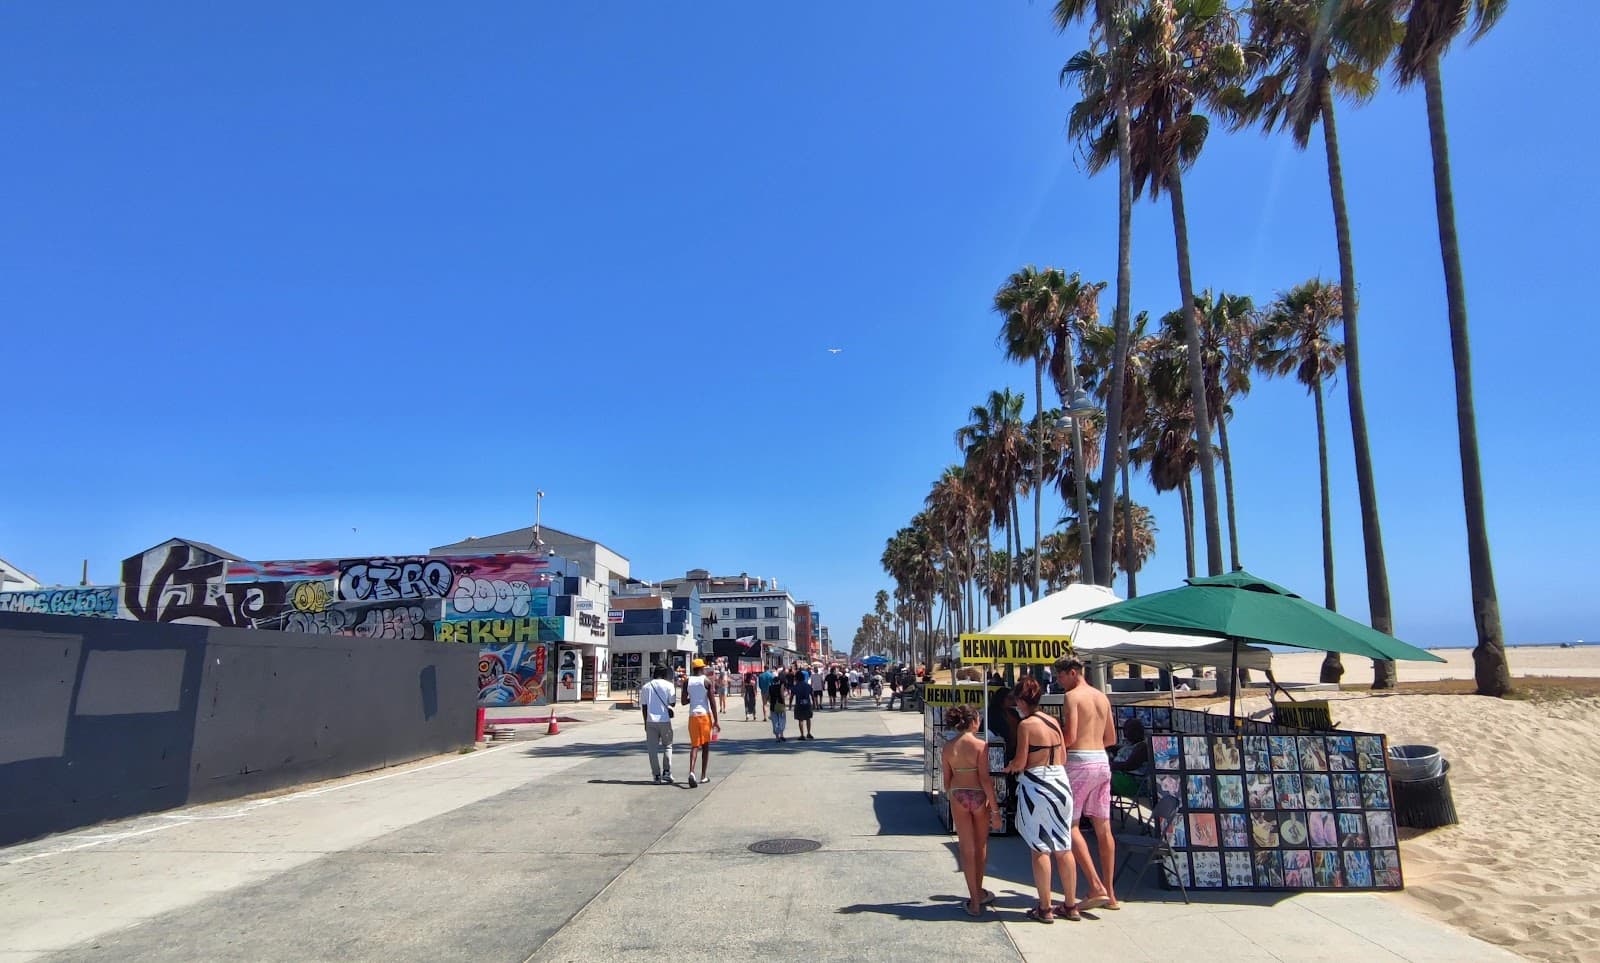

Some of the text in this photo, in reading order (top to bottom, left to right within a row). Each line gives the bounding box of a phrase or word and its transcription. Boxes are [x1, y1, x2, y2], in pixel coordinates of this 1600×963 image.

[963, 639, 1071, 659] HENNA TATTOOS
[927, 687, 961, 703] HENNA
